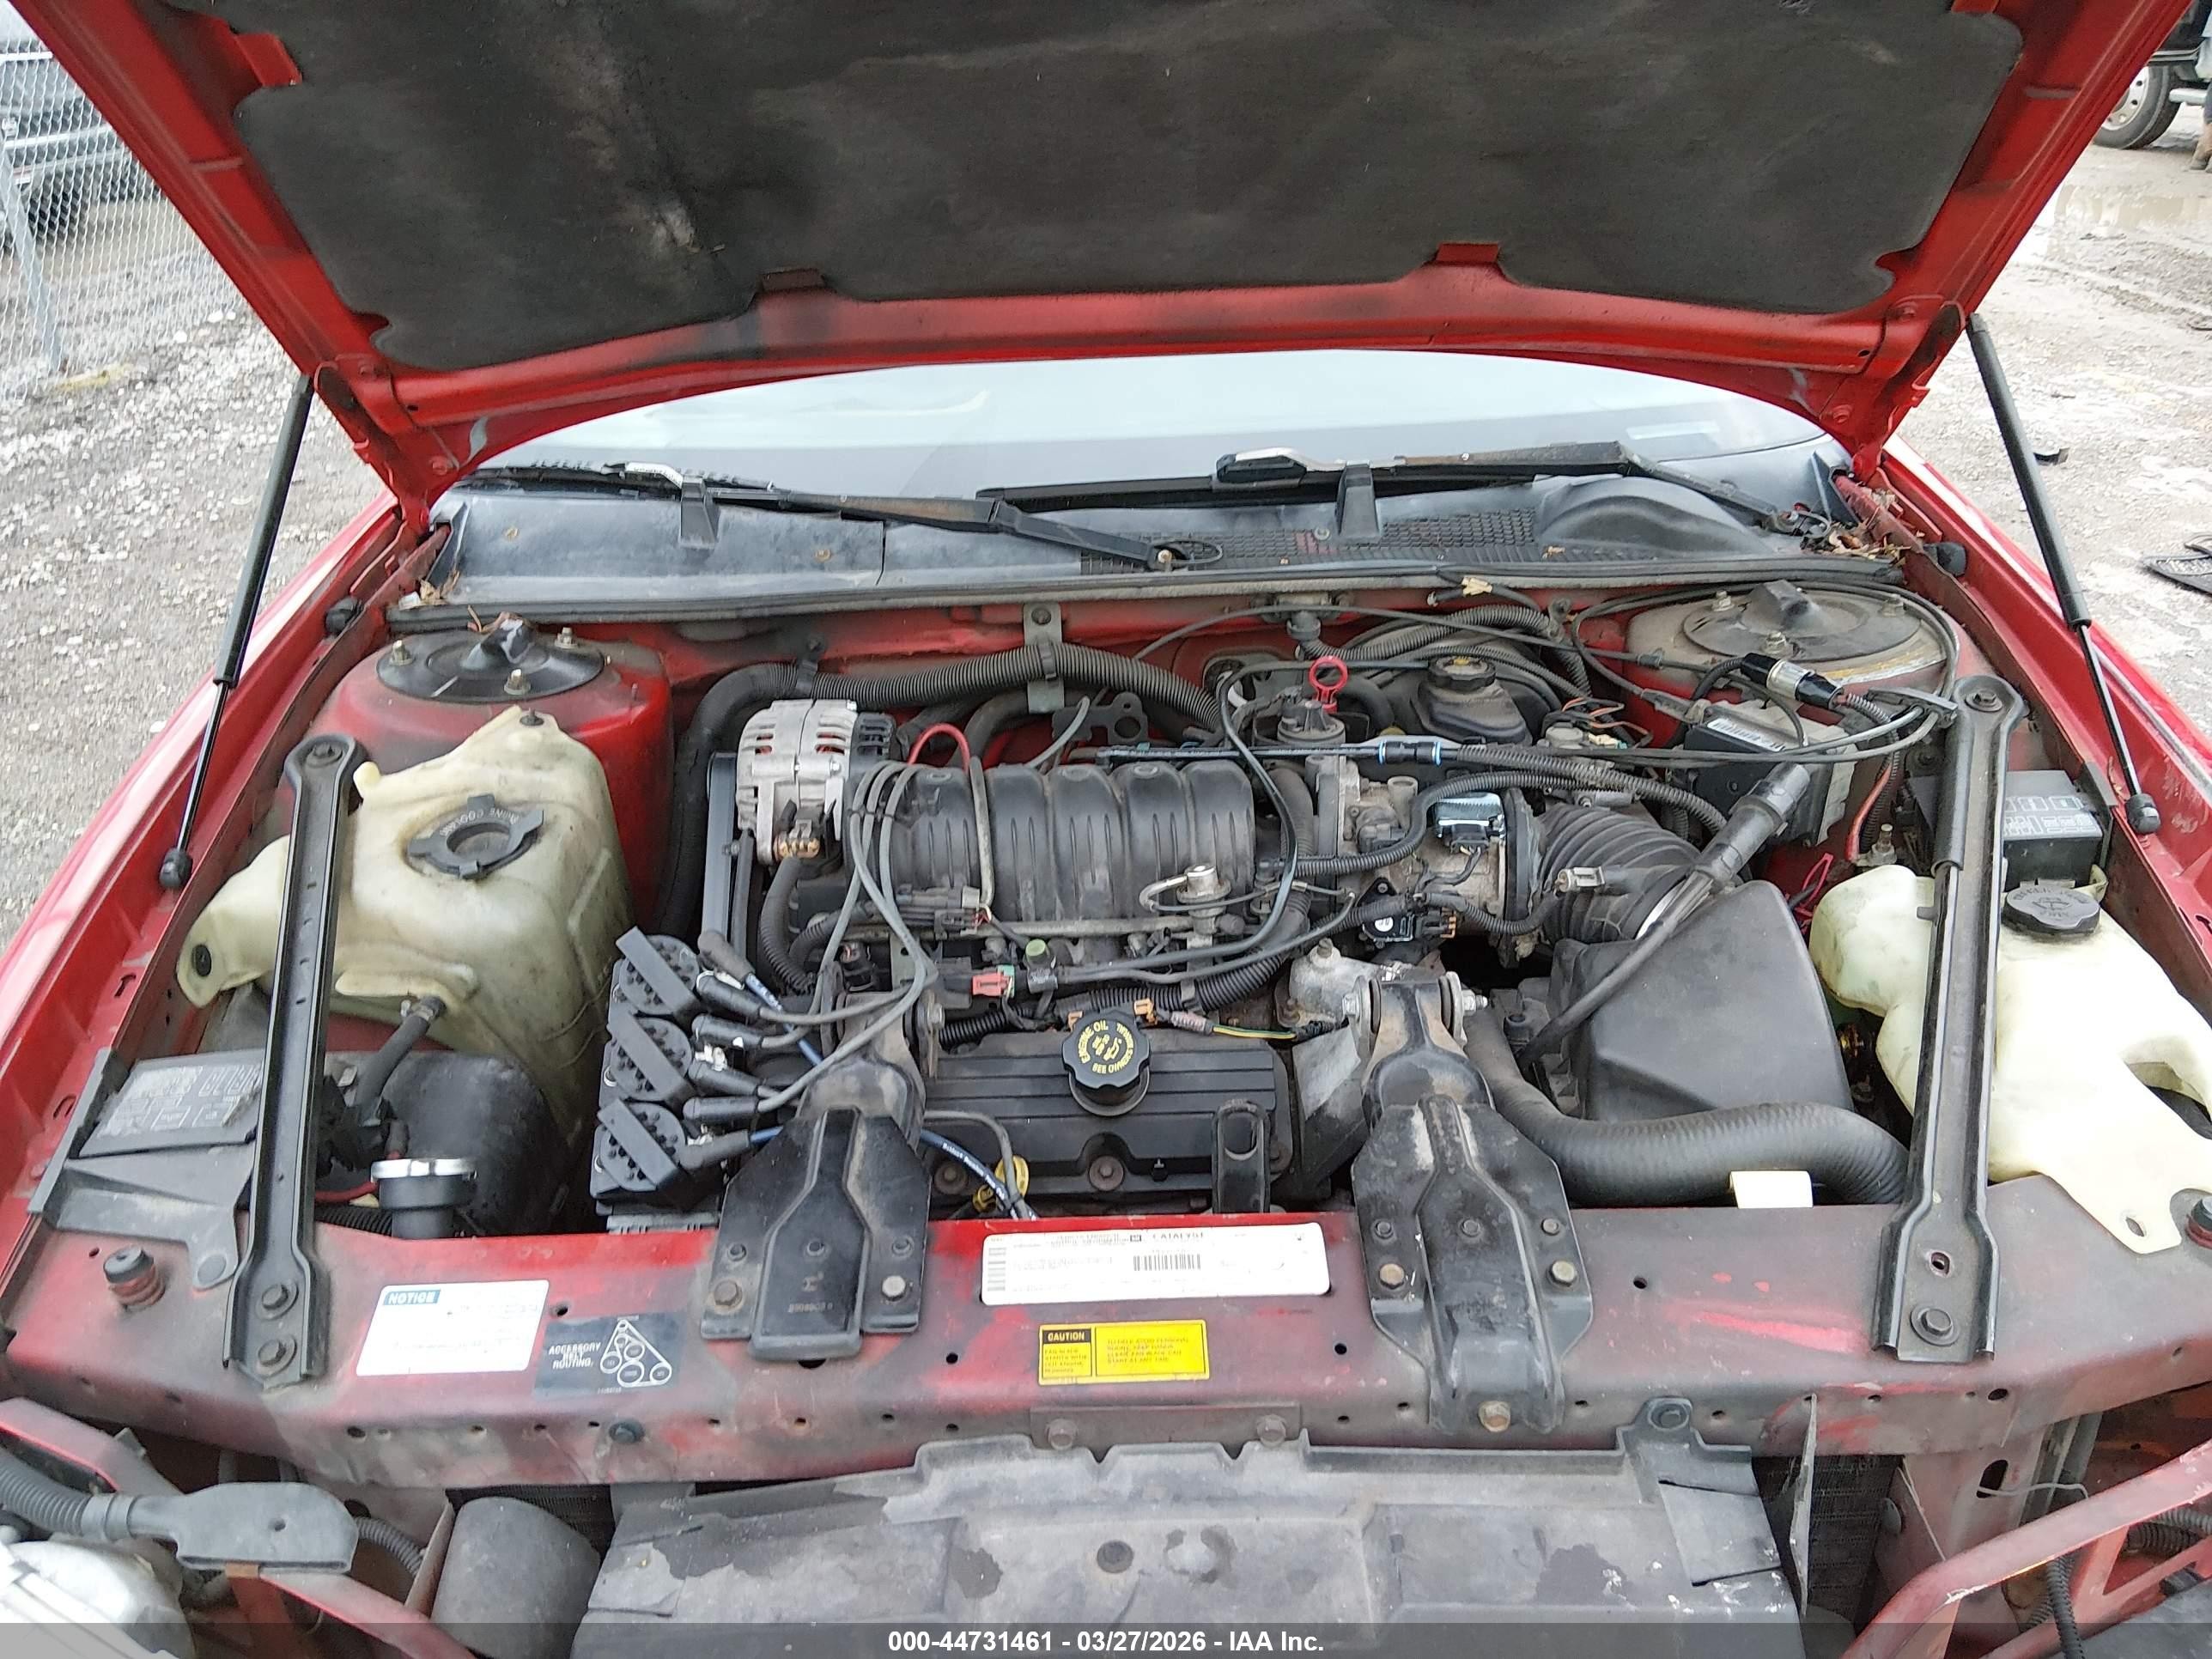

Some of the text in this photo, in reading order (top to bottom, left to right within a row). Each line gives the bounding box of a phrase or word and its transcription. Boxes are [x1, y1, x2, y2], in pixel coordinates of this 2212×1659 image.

[1093, 1019, 1109, 1032] OIL
[388, 1291, 435, 1304] NOTICE
[1048, 1332, 1085, 1342] CAUTION
